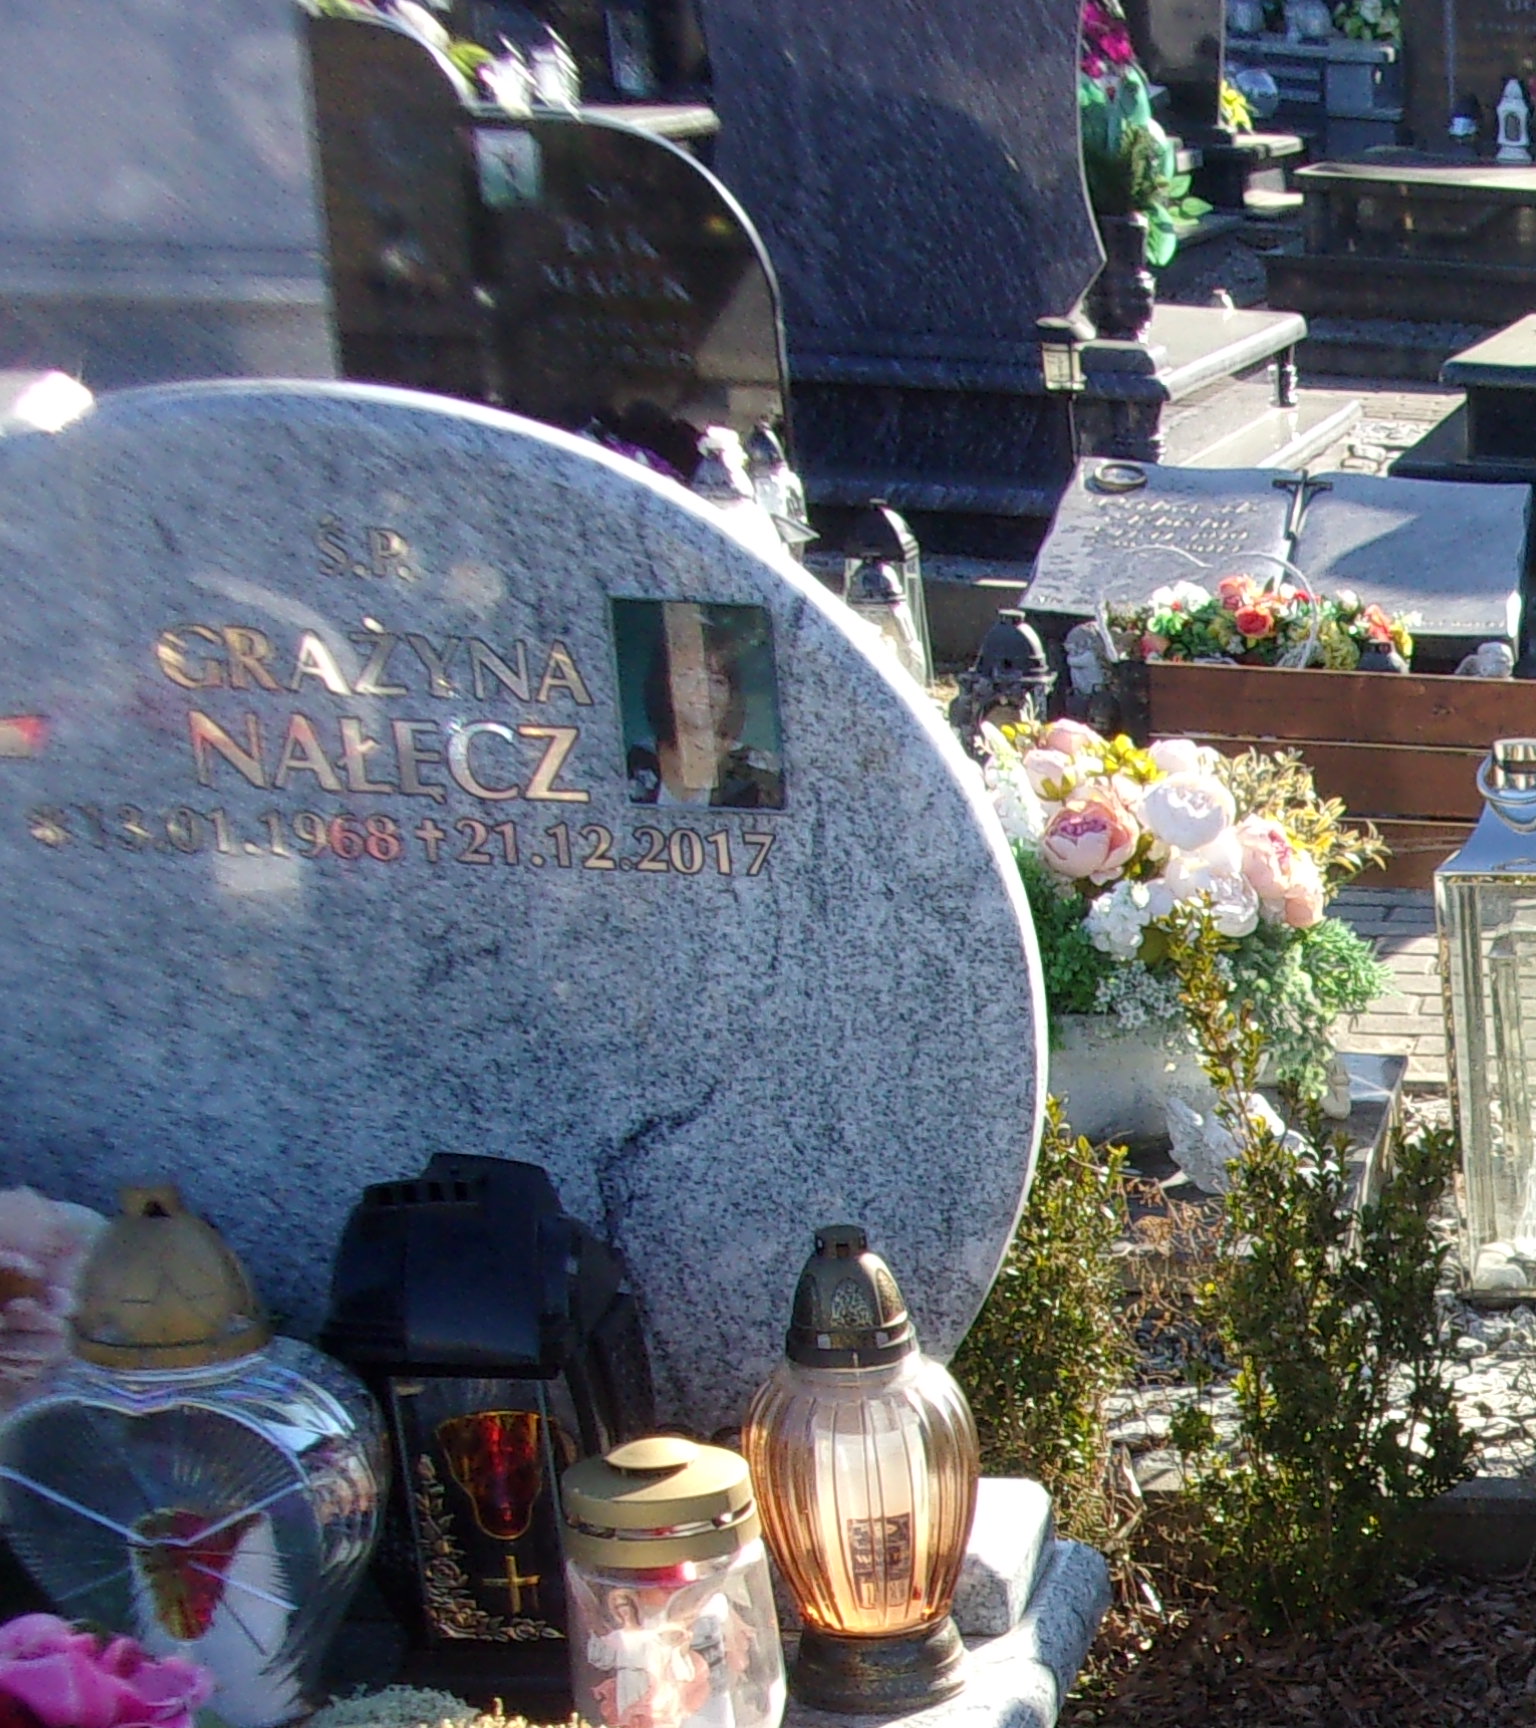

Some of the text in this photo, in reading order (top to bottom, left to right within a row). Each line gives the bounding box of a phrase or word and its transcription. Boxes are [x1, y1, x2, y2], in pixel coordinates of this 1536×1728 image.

[312, 512, 423, 582] Ś.P.
[155, 615, 594, 706] GRAŻYNA
[187, 709, 591, 803] NAŁĘCZ
